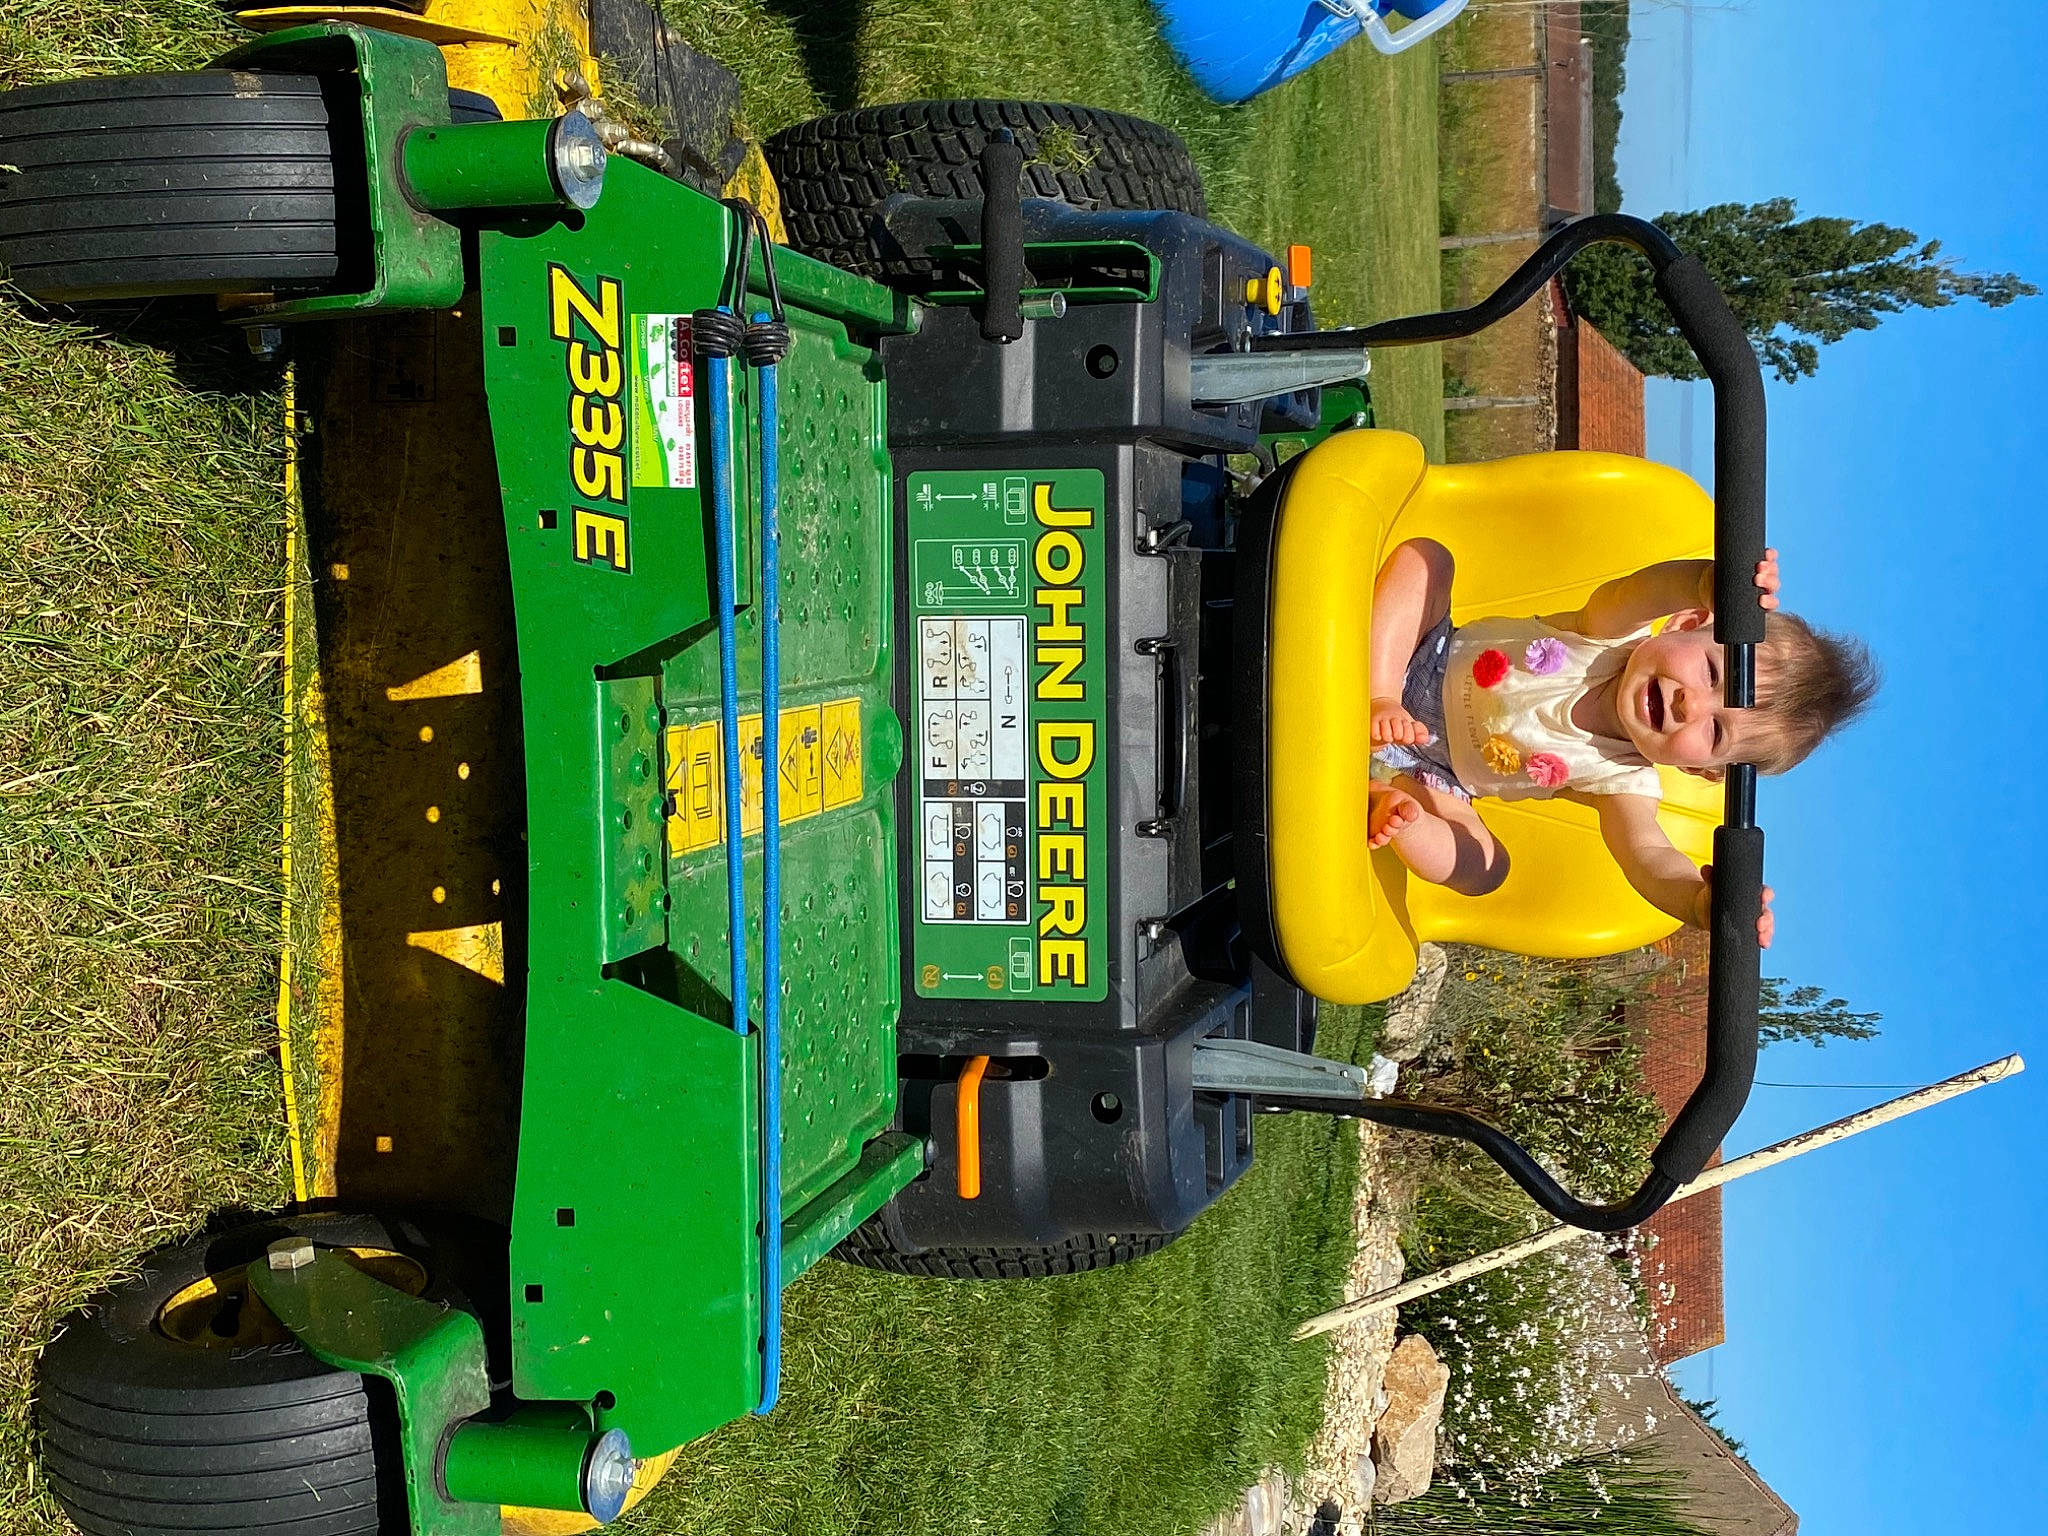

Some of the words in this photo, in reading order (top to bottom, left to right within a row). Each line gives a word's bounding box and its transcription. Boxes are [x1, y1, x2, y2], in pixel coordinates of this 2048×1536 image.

[679, 320, 692, 394] A.Cottet
[1032, 482, 1095, 702] JOHN
[932, 676, 948, 688] R
[1463, 674, 1474, 709] LITTLE
[1001, 716, 1016, 728] N
[1465, 716, 1481, 750] FLOWER
[932, 756, 947, 768] F
[1034, 720, 1097, 987] DEERE
